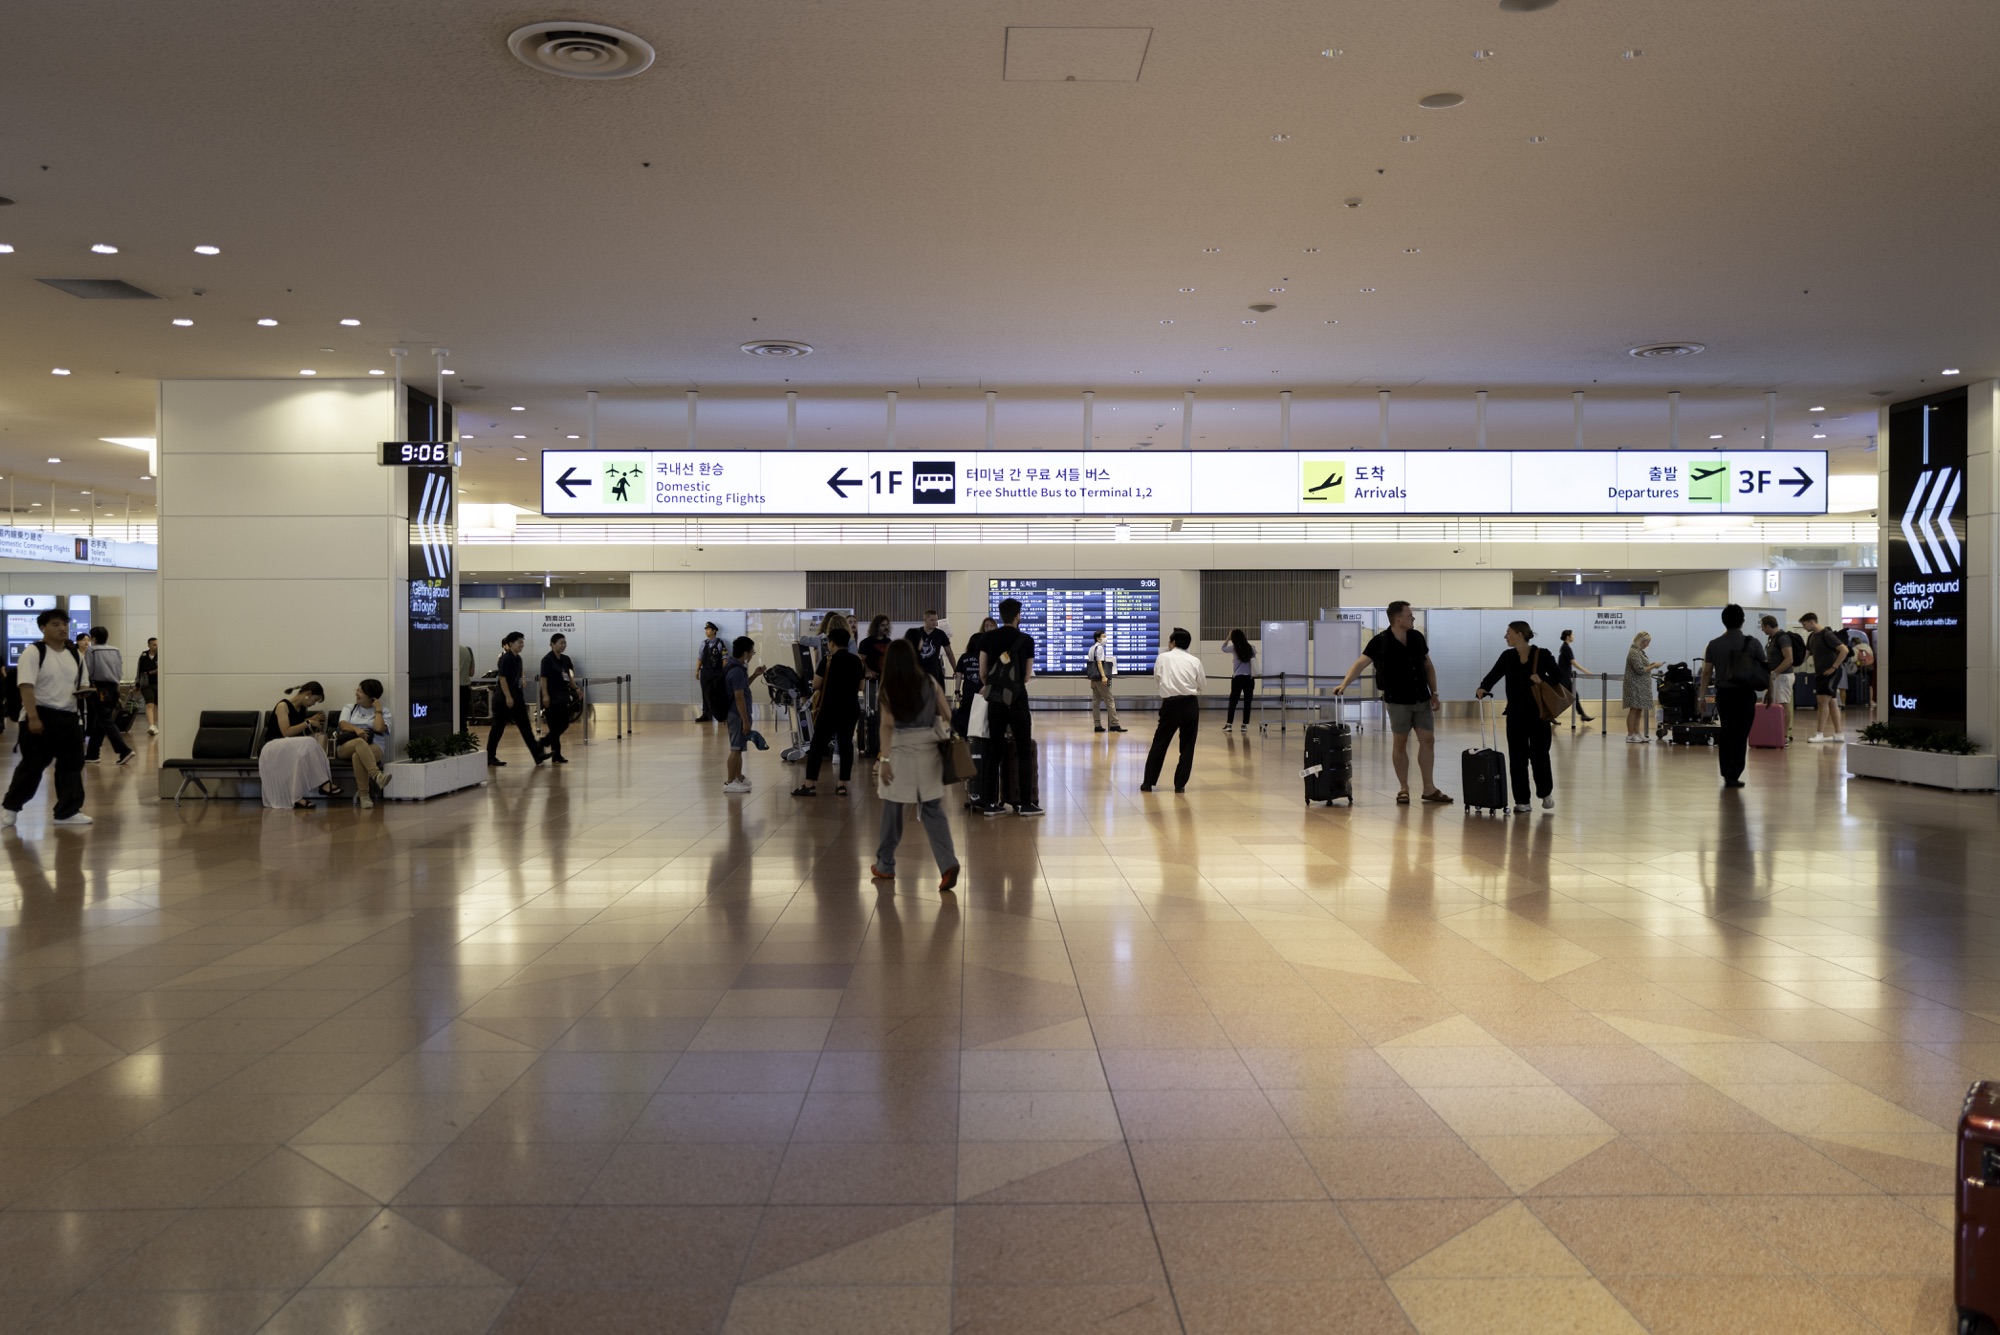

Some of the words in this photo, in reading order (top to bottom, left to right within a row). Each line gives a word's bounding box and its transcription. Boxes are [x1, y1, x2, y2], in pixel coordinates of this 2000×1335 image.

[401, 444, 445, 462] 9:06
[656, 462, 694, 476] 국내선
[699, 462, 724, 476] 환승
[966, 468, 1004, 481] 터미널
[1009, 468, 1021, 481] 간
[1026, 468, 1051, 481] 무료
[1055, 468, 1080, 481] 셔틀
[1086, 468, 1110, 481] 버스
[1355, 466, 1385, 481] 도착
[1649, 466, 1678, 482] 출발
[656, 481, 711, 492] Domestic
[870, 471, 902, 494] 1F
[1738, 470, 1772, 494] 3F
[966, 488, 992, 498] Free
[995, 487, 1038, 498] Shuttle
[1041, 488, 1062, 498] Bus
[1065, 488, 1077, 498] to
[1080, 487, 1132, 498] Terminal
[1135, 488, 1152, 499] 1,2
[1355, 486, 1407, 498] Arrivals
[1608, 487, 1679, 500] Departures
[656, 493, 723, 506] Connecting
[726, 493, 766, 506] Flights
[23, 541, 52, 552] Connecting
[53, 544, 70, 553] Flights
[1893, 581, 1926, 597] Getting
[1926, 579, 1960, 593] around
[1893, 598, 1902, 610] in
[1901, 596, 1934, 613] Tokyo?
[1900, 618, 1919, 628] Request
[1944, 617, 1958, 626] Uber
[1893, 694, 1918, 710] Uber
[412, 703, 428, 718] Uber
